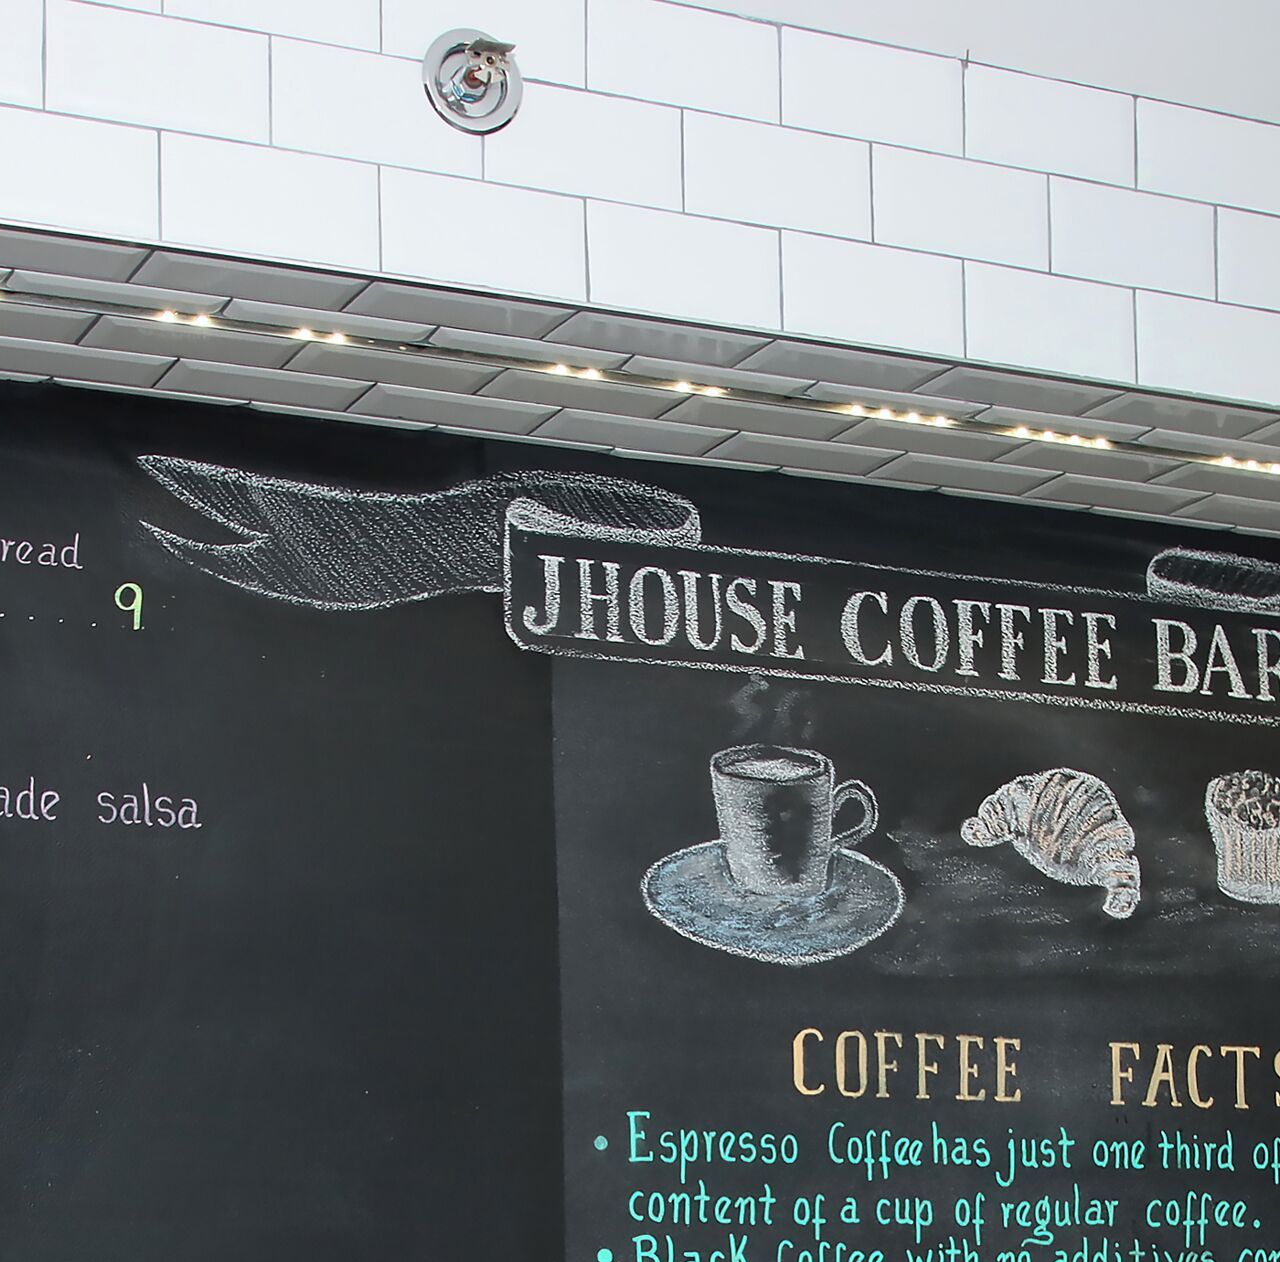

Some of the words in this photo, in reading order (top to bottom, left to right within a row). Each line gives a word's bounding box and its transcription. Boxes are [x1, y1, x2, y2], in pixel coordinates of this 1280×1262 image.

[115, 582, 143, 631] 9
[840, 590, 1120, 692] COFFEE
[97, 782, 203, 830] salsa
[792, 1027, 1022, 1102] COFFEE
[626, 1111, 799, 1184] Espresso
[828, 1121, 922, 1181] Coffee
[931, 1121, 991, 1167] has
[995, 1126, 1075, 1188] just
[1093, 1139, 1145, 1169] one
[1158, 1129, 1233, 1172] third
[628, 1179, 777, 1226] content
[792, 1193, 826, 1240] of
[840, 1196, 860, 1226] a
[876, 1196, 933, 1244] cup
[954, 1193, 987, 1245] of
[1001, 1183, 1119, 1247] regular
[1145, 1190, 1261, 1247] coffee.
